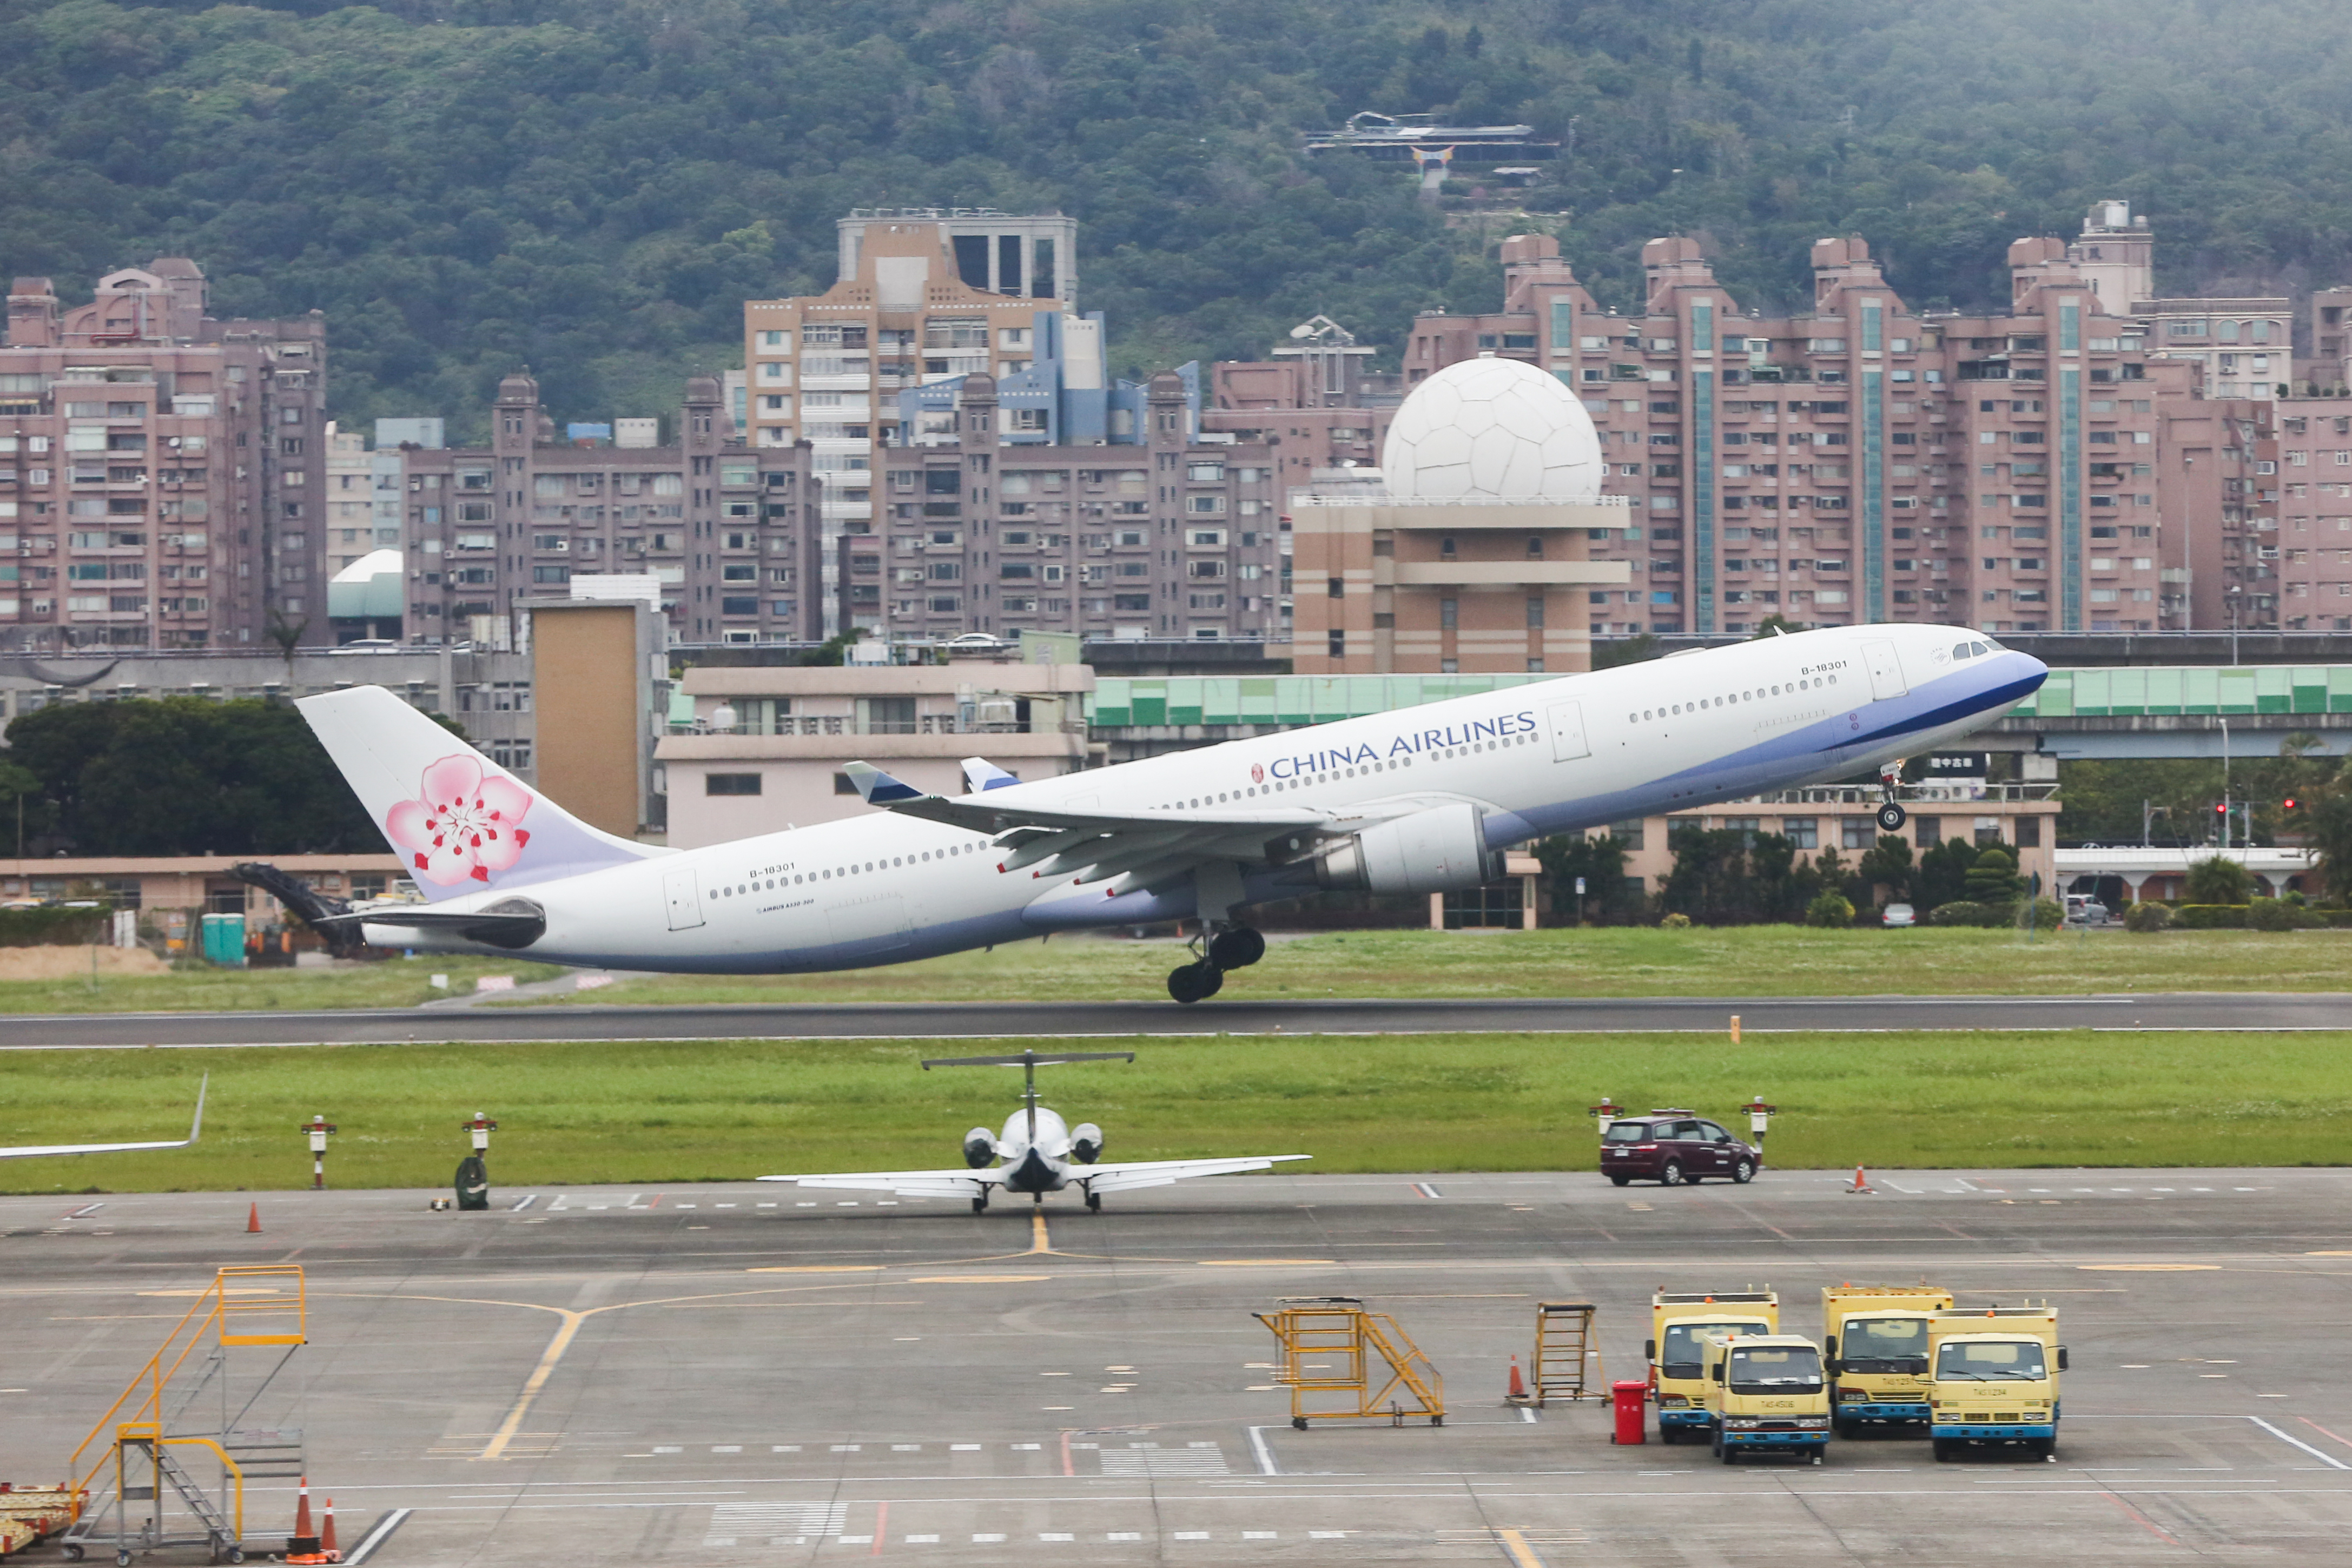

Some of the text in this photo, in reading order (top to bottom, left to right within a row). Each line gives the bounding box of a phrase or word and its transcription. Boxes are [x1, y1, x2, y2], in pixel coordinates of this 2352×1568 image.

[1801, 660, 1847, 675] B-18301
[1271, 743, 1379, 778] CHINA
[1389, 711, 1536, 757] AIRLINES
[750, 862, 795, 878] B-18301
[763, 898, 814, 912] AIRBUS A330-300
